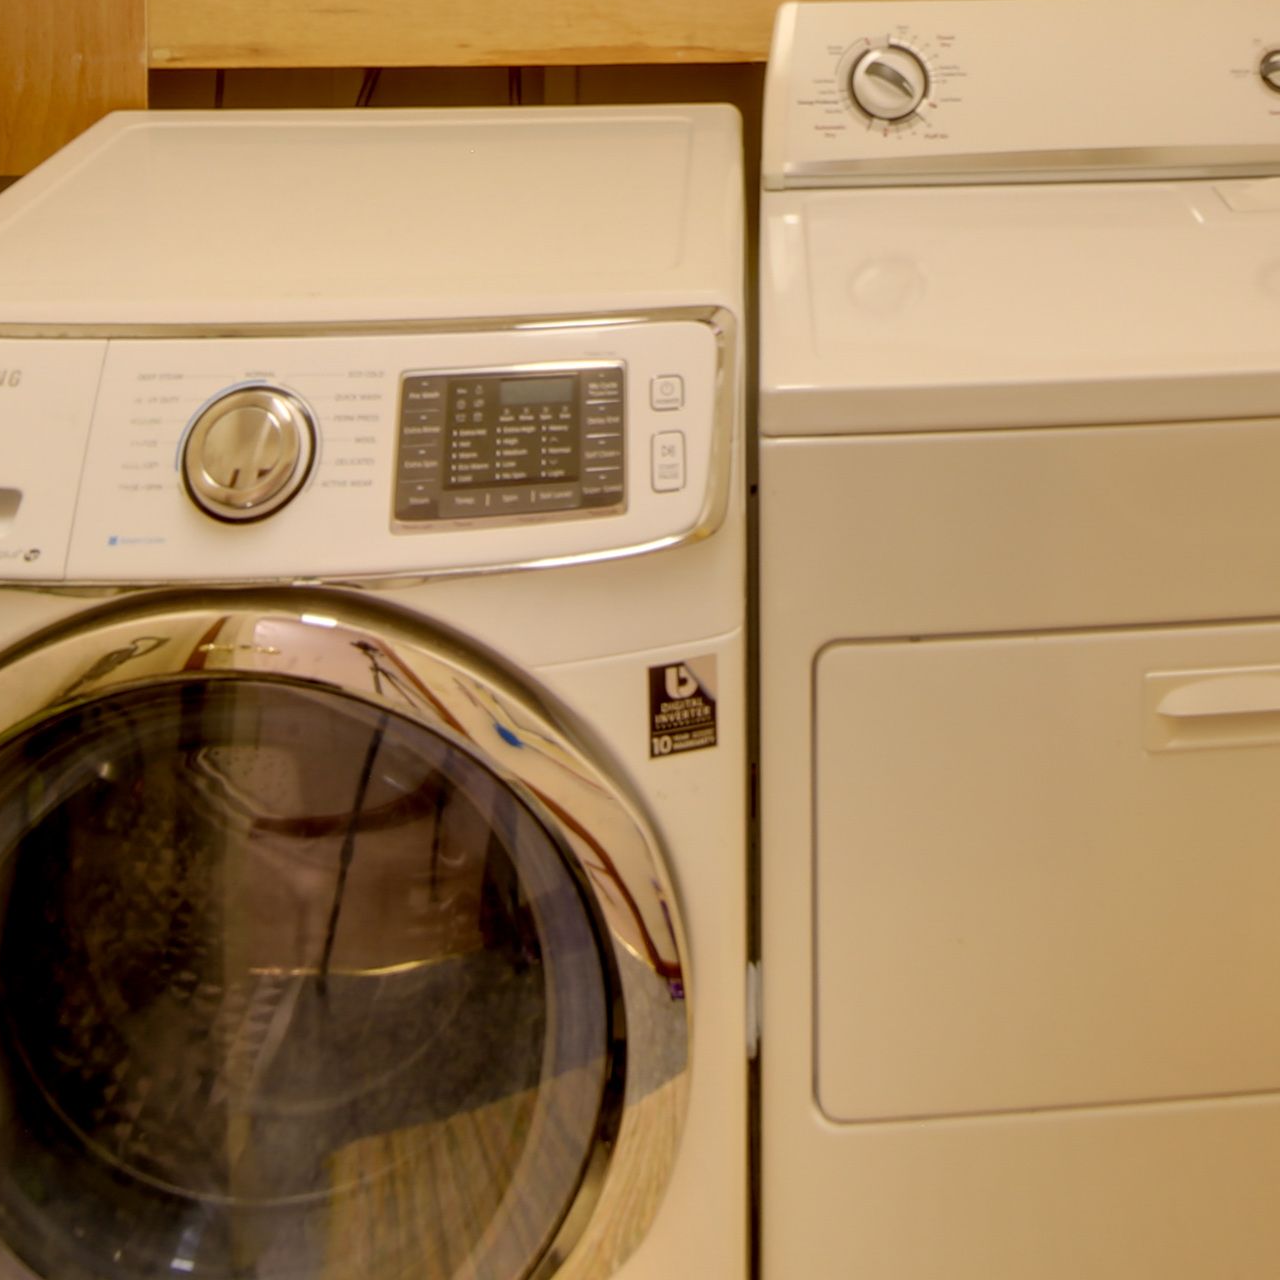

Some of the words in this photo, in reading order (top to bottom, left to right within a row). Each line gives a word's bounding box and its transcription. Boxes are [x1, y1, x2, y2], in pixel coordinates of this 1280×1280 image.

[654, 705, 712, 724] INVERTER
[660, 697, 704, 713] DIGITAL
[652, 734, 673, 755] 10
